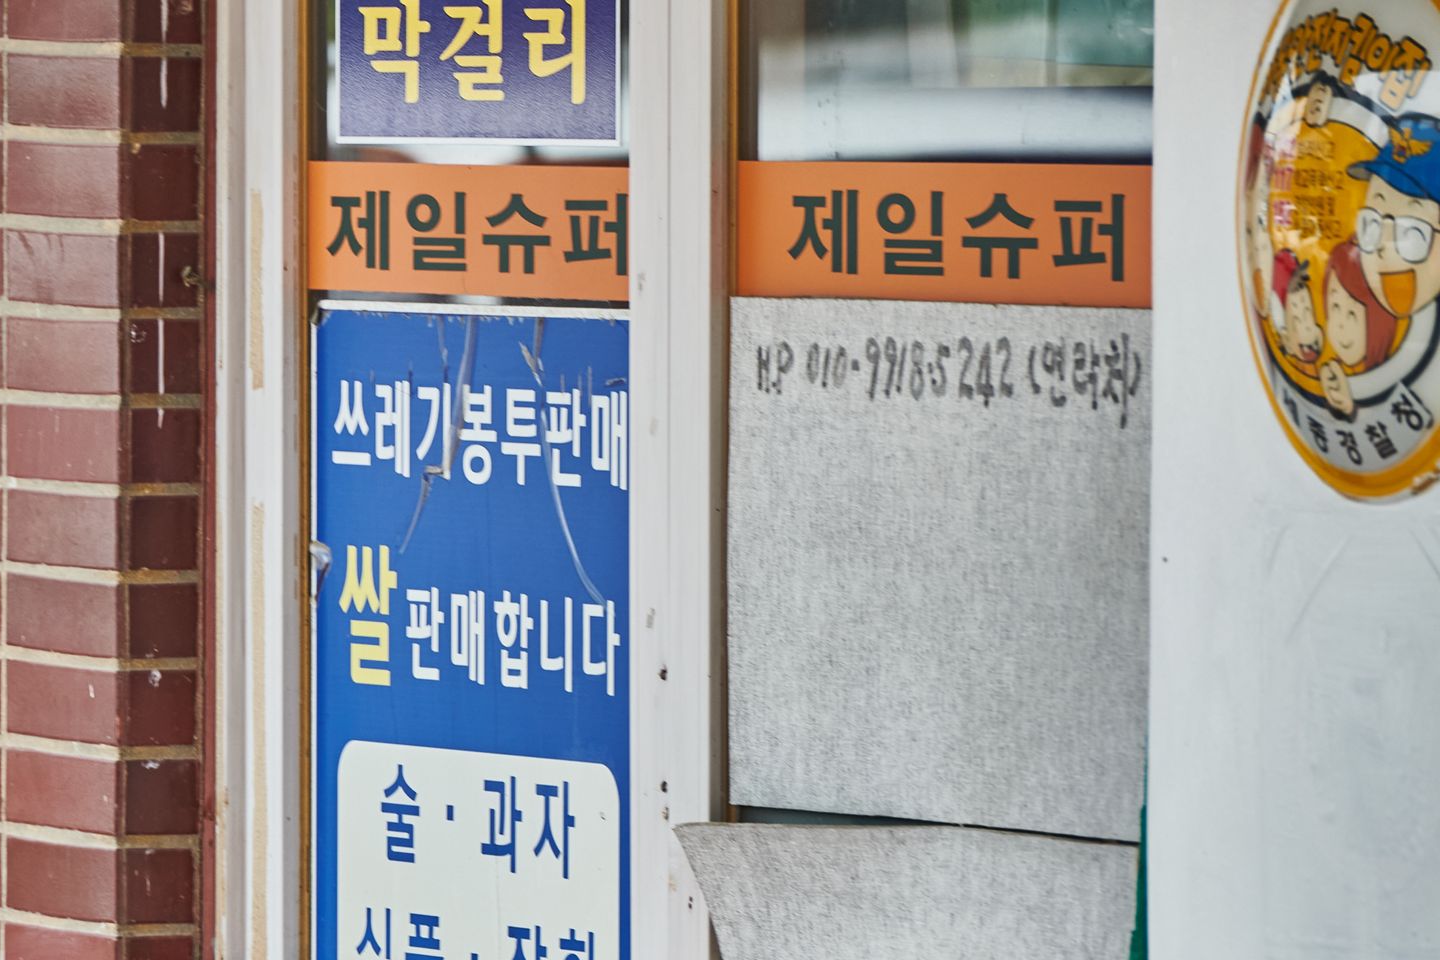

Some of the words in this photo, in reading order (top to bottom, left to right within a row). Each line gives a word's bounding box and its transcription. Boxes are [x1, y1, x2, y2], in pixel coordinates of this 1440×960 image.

[358, 0, 586, 105] 막걸리
[326, 190, 628, 277] 제일슈퍼
[788, 189, 1126, 282] 제일슈퍼
[338, 543, 398, 687] 쌀
[405, 585, 621, 697] 판매합니다
